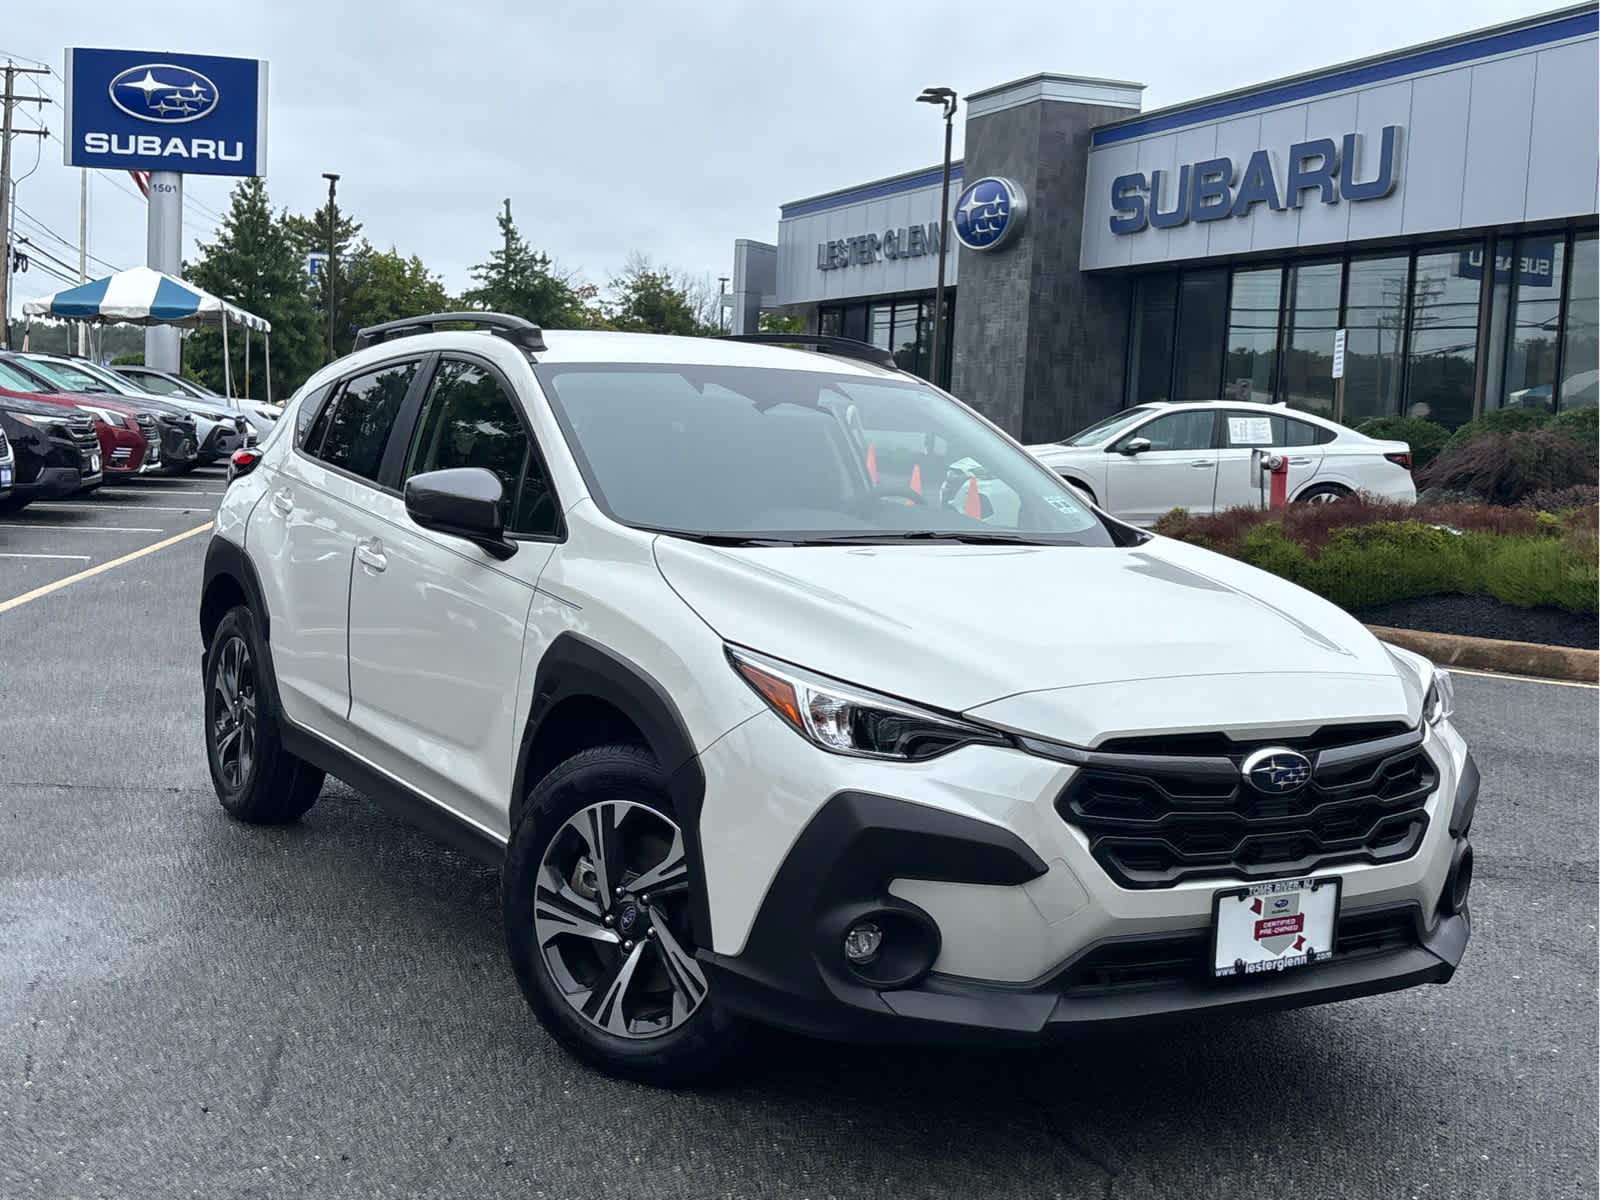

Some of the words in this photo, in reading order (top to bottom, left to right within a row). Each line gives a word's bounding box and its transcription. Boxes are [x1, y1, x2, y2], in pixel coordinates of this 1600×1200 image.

[84, 132, 244, 162] SUBARU
[152, 184, 177, 193] 1501
[1109, 125, 1402, 235] SUBARU
[817, 232, 882, 272] LESTER
[1259, 924, 1299, 936] PRE-OWNED
[1263, 918, 1297, 929] CERTIFIED
